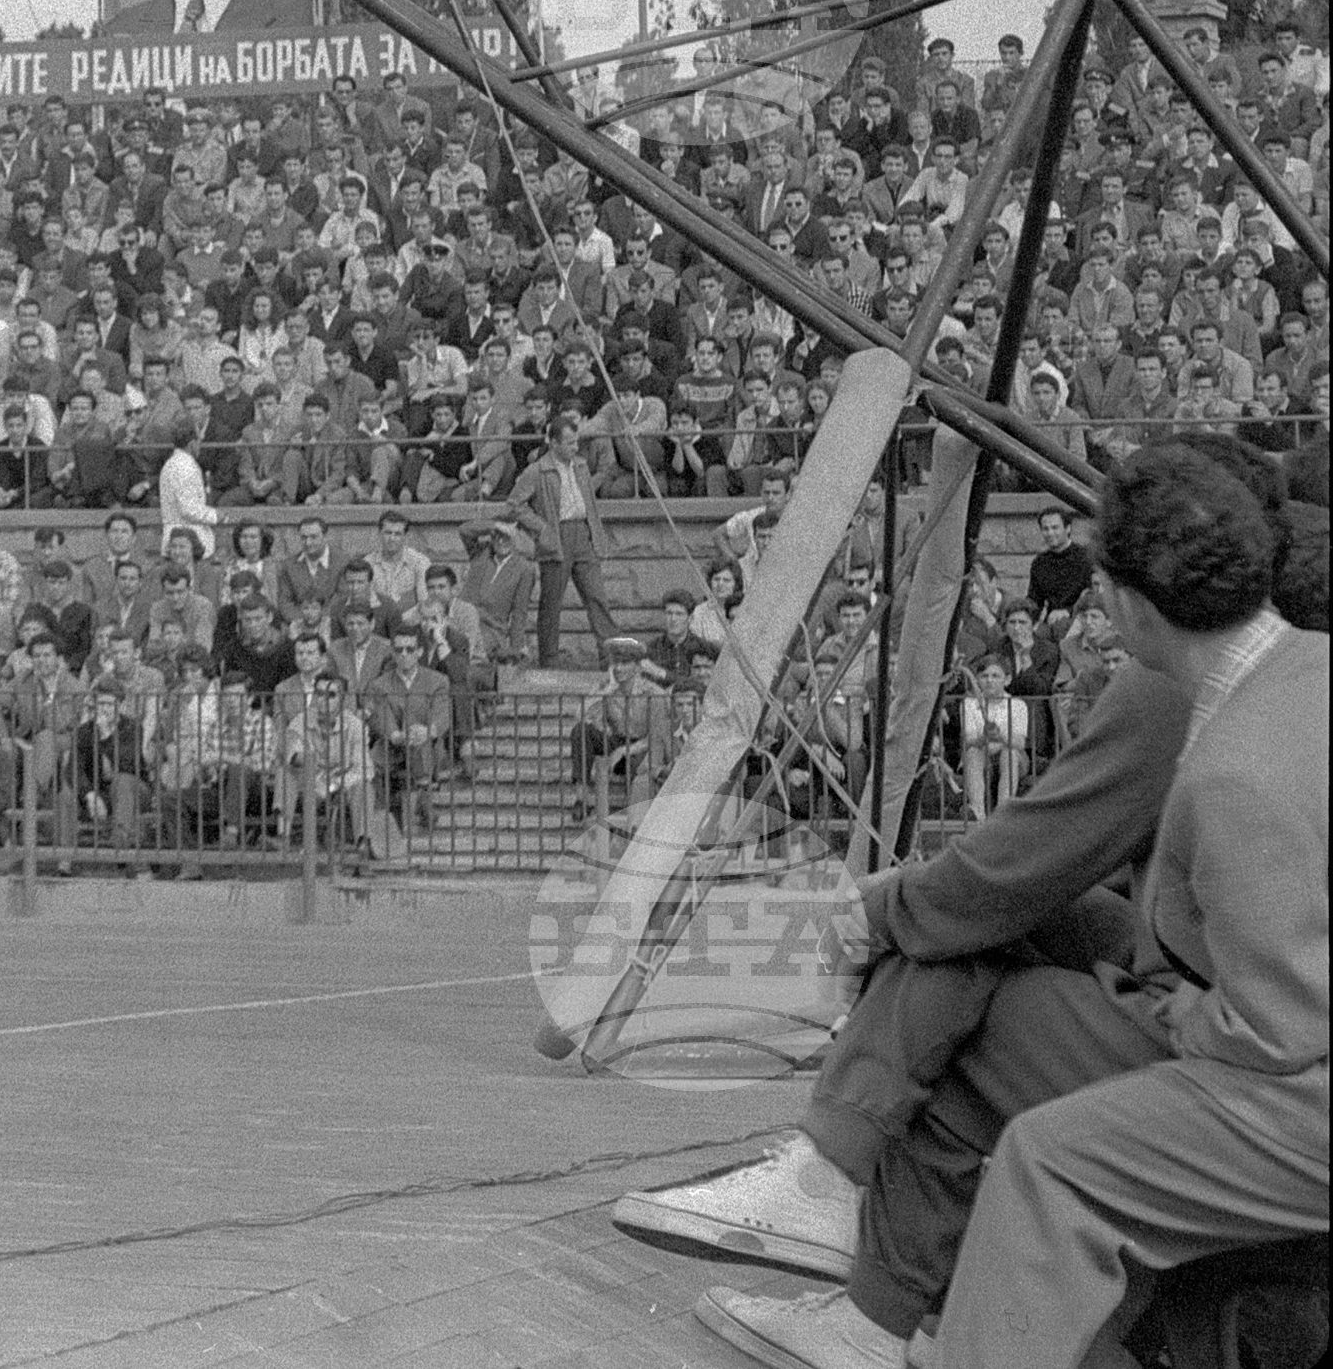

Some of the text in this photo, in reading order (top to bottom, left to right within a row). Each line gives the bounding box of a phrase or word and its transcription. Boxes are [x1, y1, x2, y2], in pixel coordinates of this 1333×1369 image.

[71, 45, 192, 93] РЕДИЦИ
[199, 55, 232, 84] НА
[237, 35, 368, 82] БОРБАТА
[379, 33, 417, 76] ЗА
